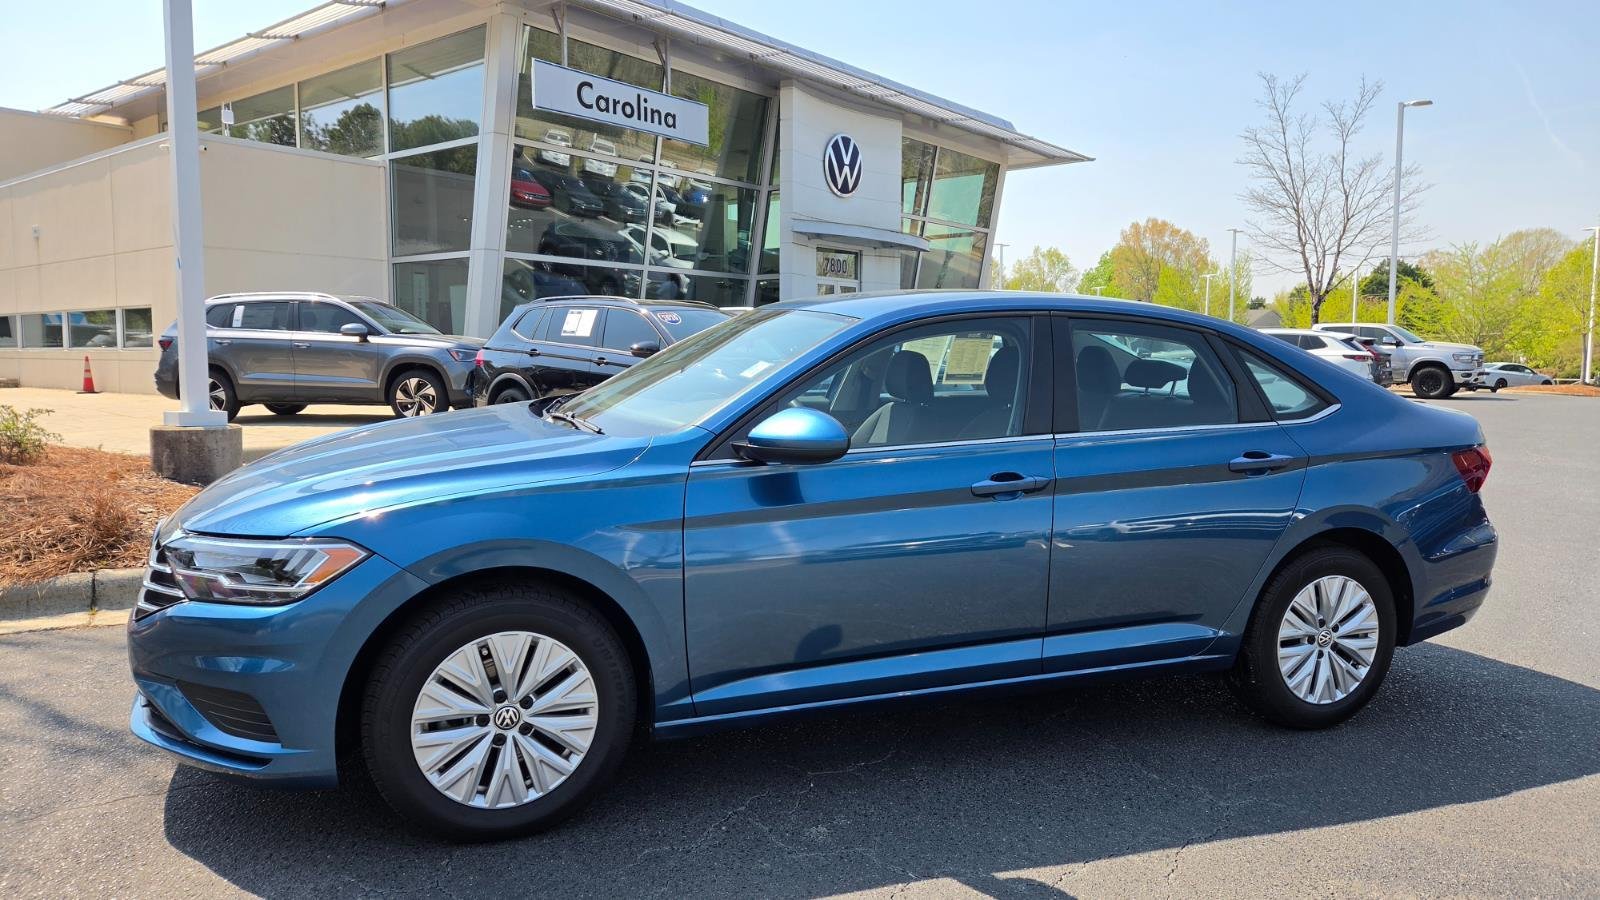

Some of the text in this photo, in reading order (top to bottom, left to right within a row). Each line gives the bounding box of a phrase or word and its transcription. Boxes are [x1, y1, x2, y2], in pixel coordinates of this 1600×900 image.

[576, 81, 677, 129] Carolina
[825, 134, 863, 197] VW
[824, 258, 848, 274] 7800
